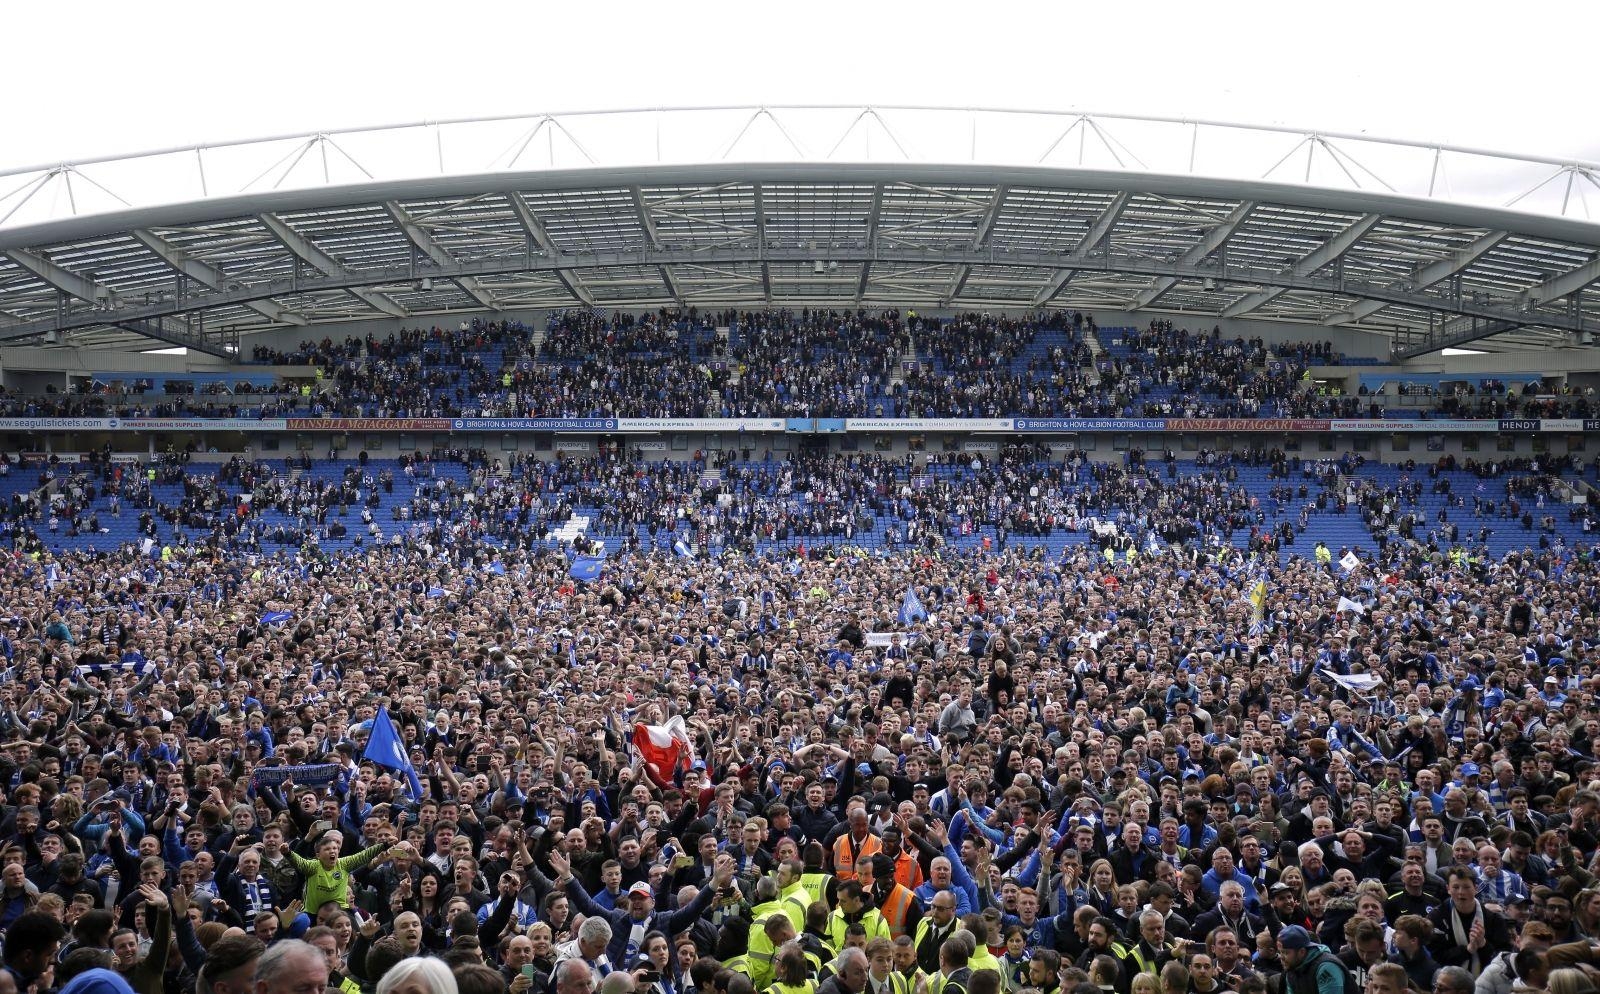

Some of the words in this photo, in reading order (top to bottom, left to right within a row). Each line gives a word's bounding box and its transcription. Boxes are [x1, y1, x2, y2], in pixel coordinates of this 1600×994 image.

[288, 420, 345, 429] MANSELL
[346, 420, 416, 429] McTAGGART
[1167, 420, 1224, 429] MANSELL
[1225, 420, 1294, 429] McTAGGART
[313, 564, 323, 572] 69
